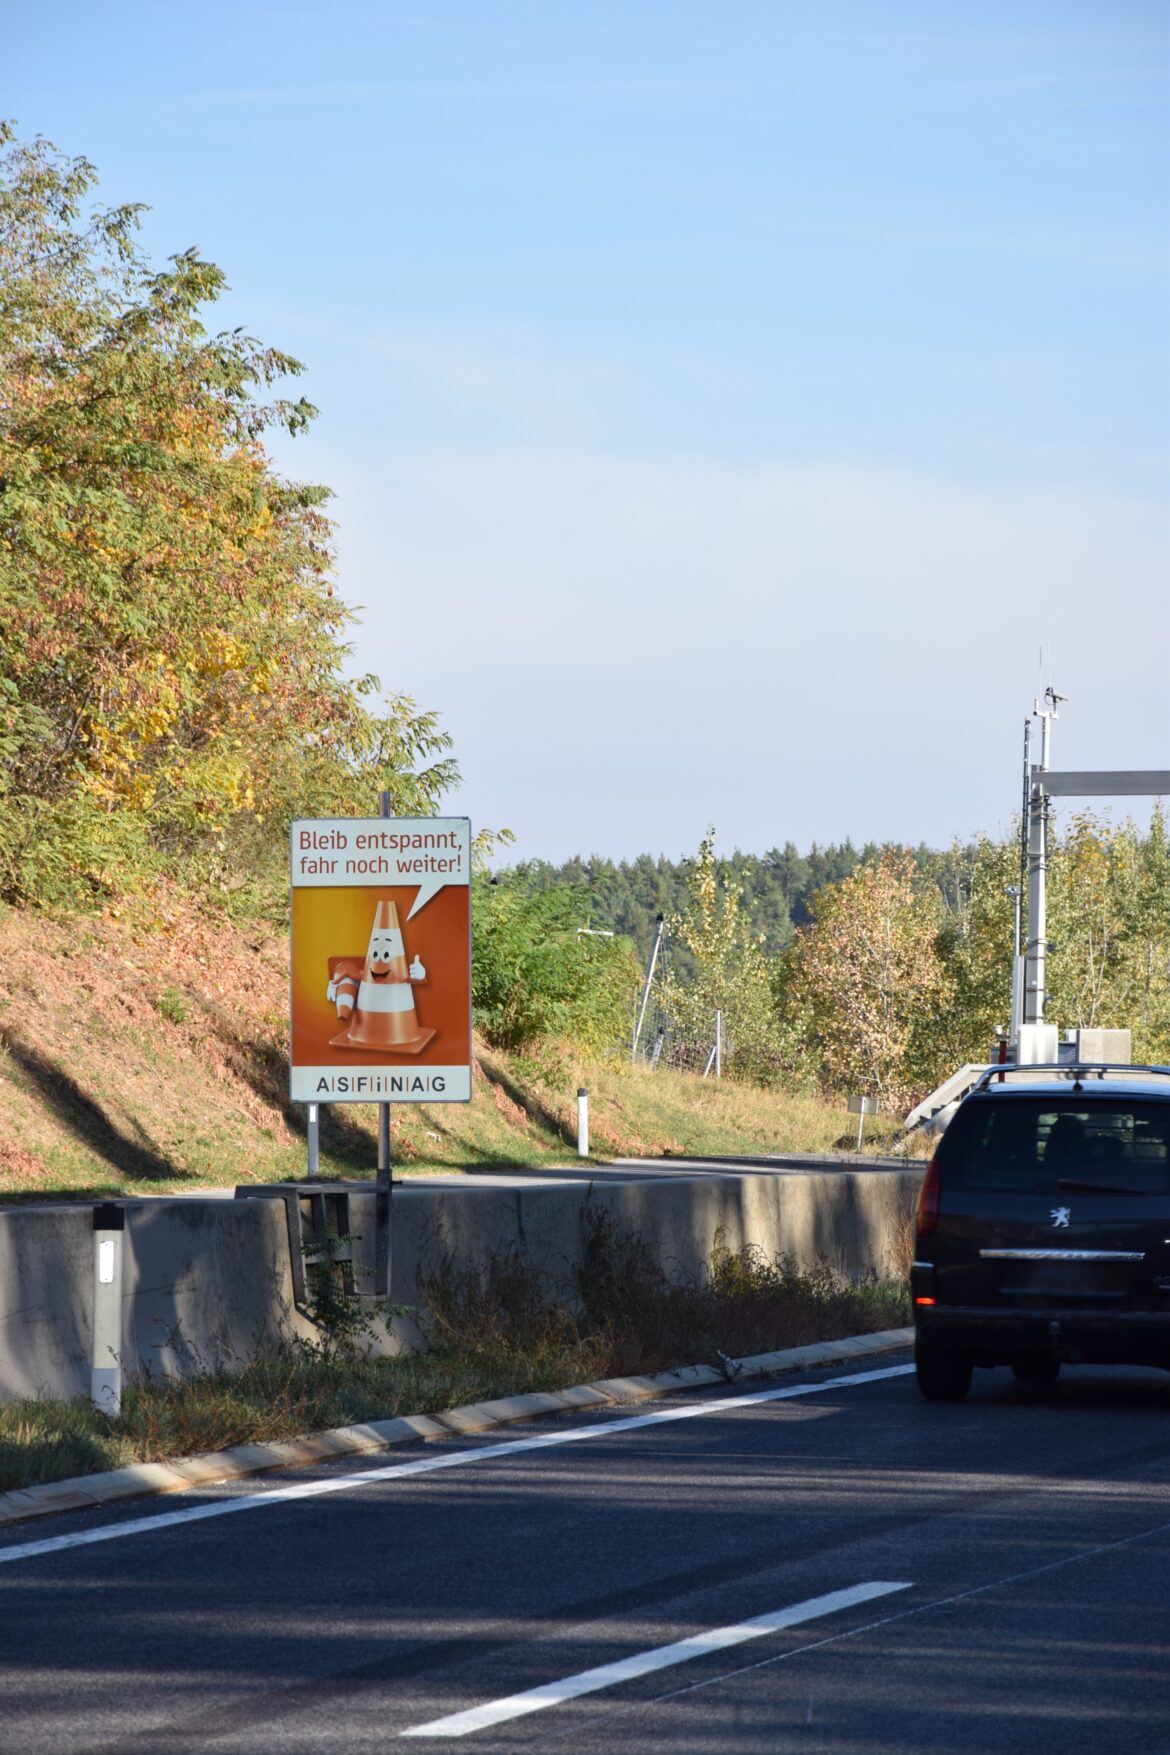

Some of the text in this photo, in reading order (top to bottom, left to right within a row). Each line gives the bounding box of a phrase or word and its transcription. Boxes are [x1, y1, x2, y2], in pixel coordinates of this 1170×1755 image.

[300, 830, 463, 853] Bleib entspannt,
[300, 854, 462, 874] fahr noch weiter!
